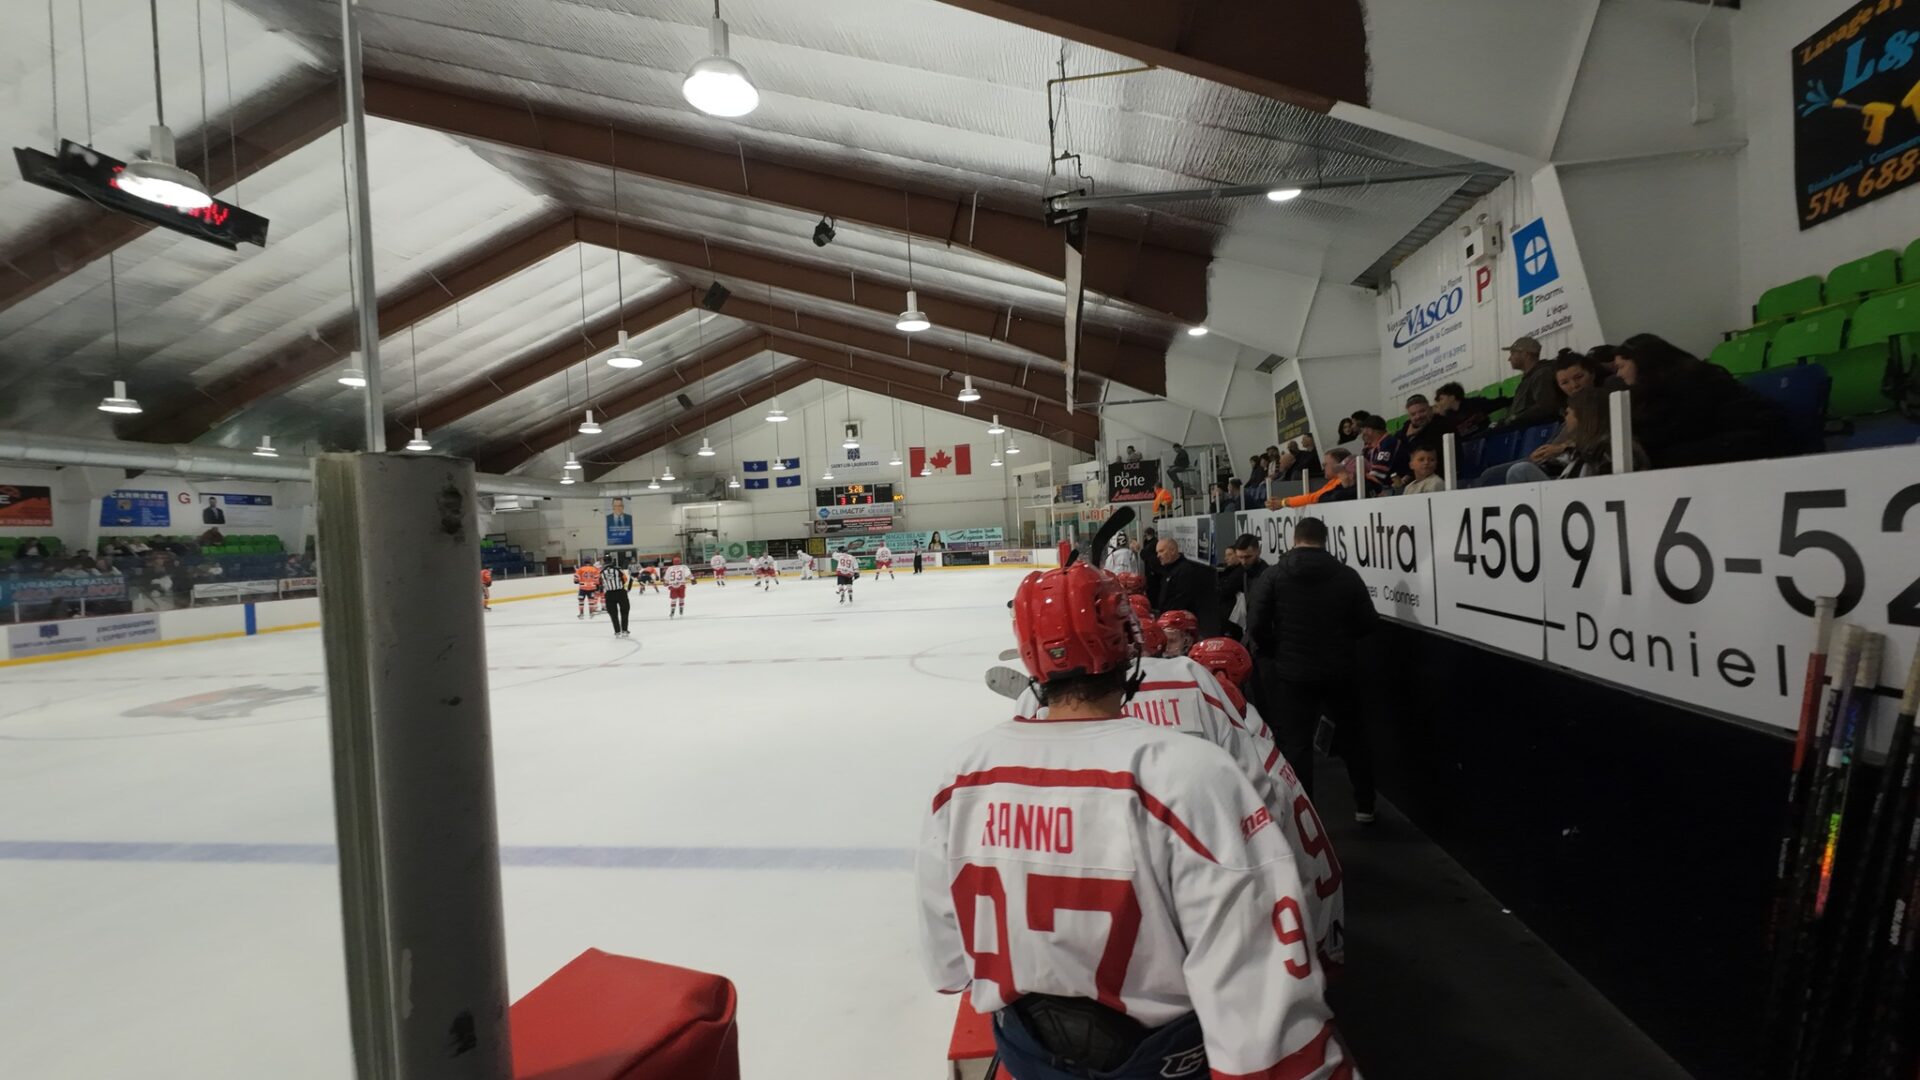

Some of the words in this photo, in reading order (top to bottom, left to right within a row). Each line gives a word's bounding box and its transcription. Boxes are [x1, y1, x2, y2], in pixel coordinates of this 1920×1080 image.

[1806, 182, 1850, 221] 514
[1476, 265, 1492, 304] P
[1406, 287, 1463, 336] VASCO
[178, 492, 191, 505] G
[1114, 475, 1145, 488] Porte
[1354, 511, 1418, 574] ultra
[1453, 503, 1541, 584] 450
[1383, 585, 1420, 608] Colonnes
[1576, 611, 1788, 698] Daniel
[982, 802, 1074, 855] RANNO
[950, 862, 1143, 1014] 97
[1272, 895, 1312, 980] 9
